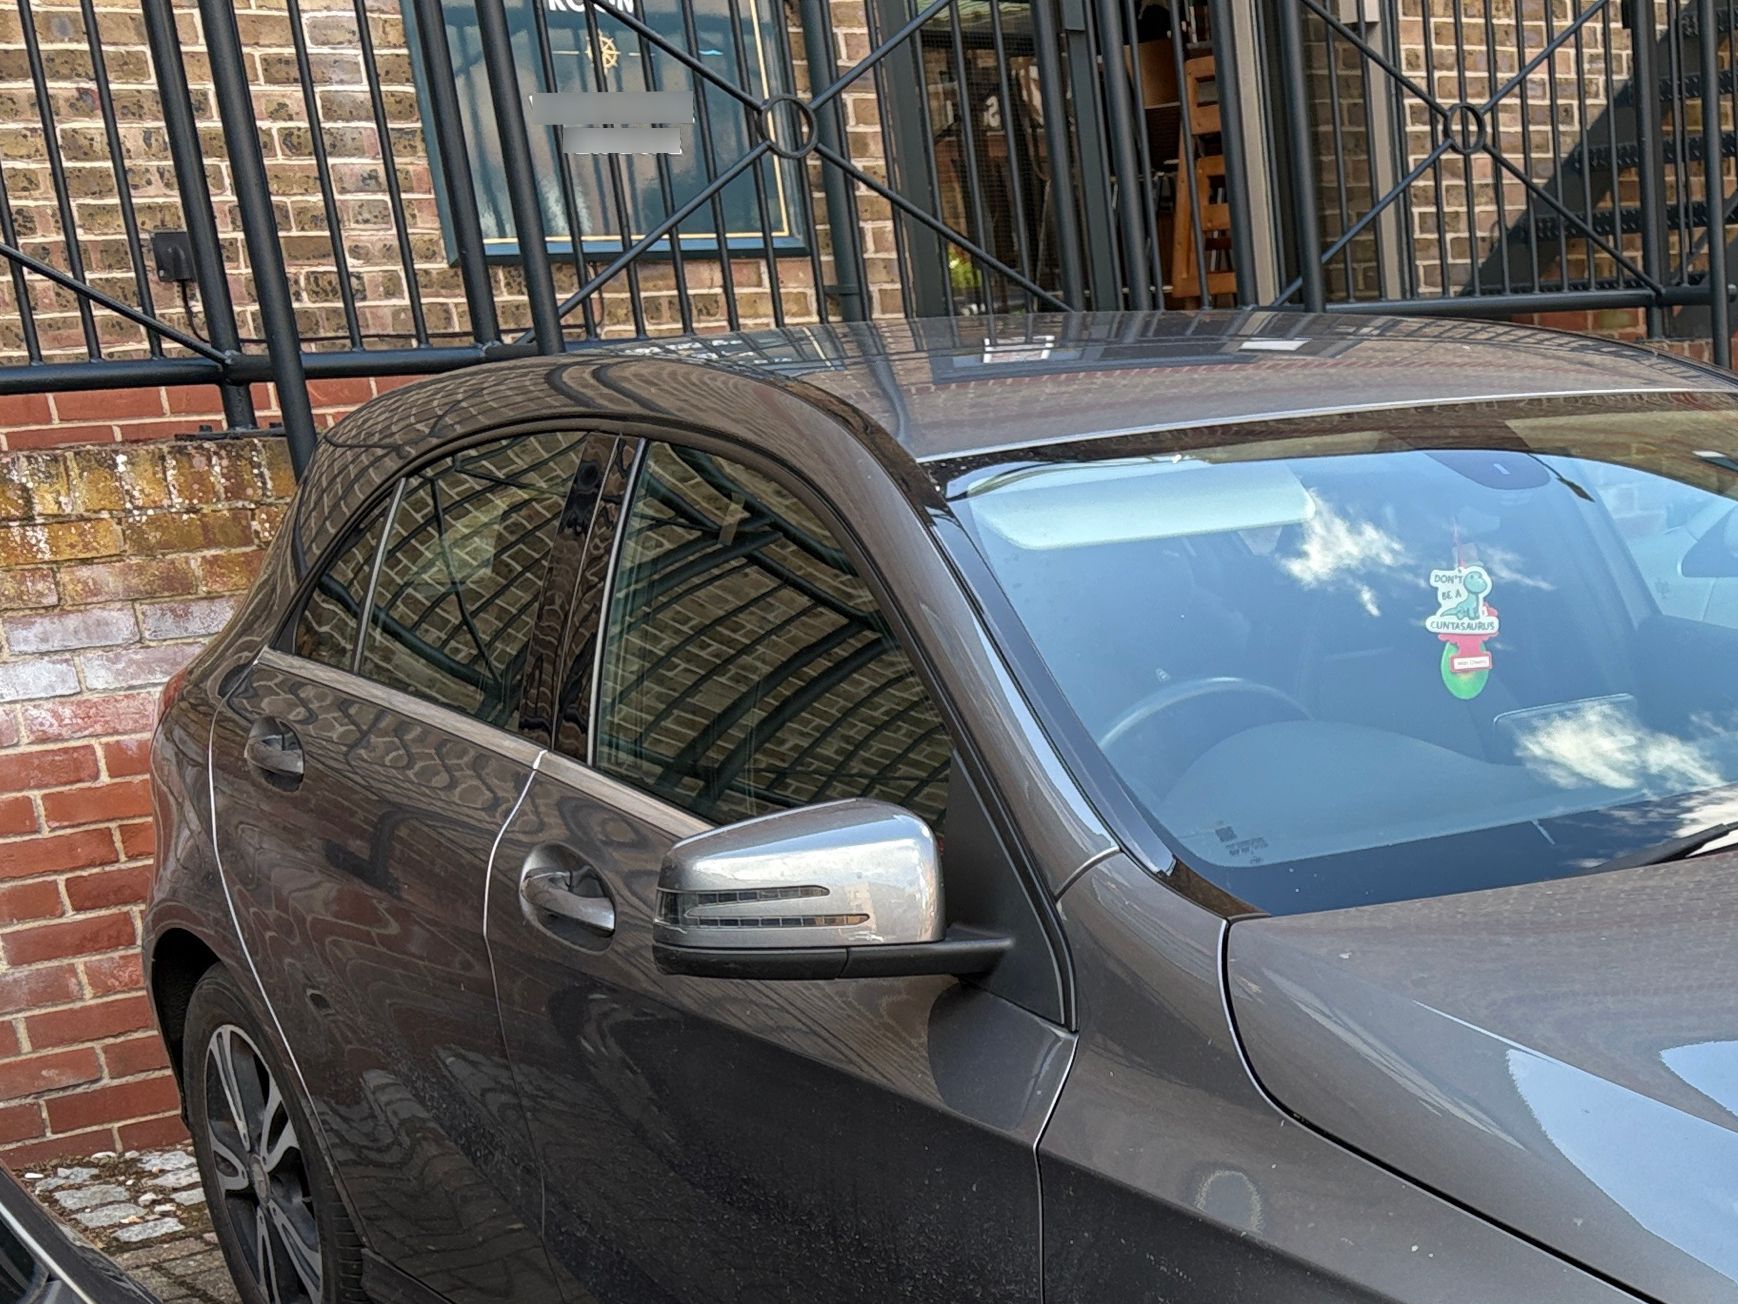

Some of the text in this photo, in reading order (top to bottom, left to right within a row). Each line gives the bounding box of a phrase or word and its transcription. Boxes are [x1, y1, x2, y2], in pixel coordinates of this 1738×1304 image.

[1434, 574, 1463, 584] DON'T
[1442, 589, 1462, 600] BE A
[1430, 621, 1495, 631] CUNTASAURUS
